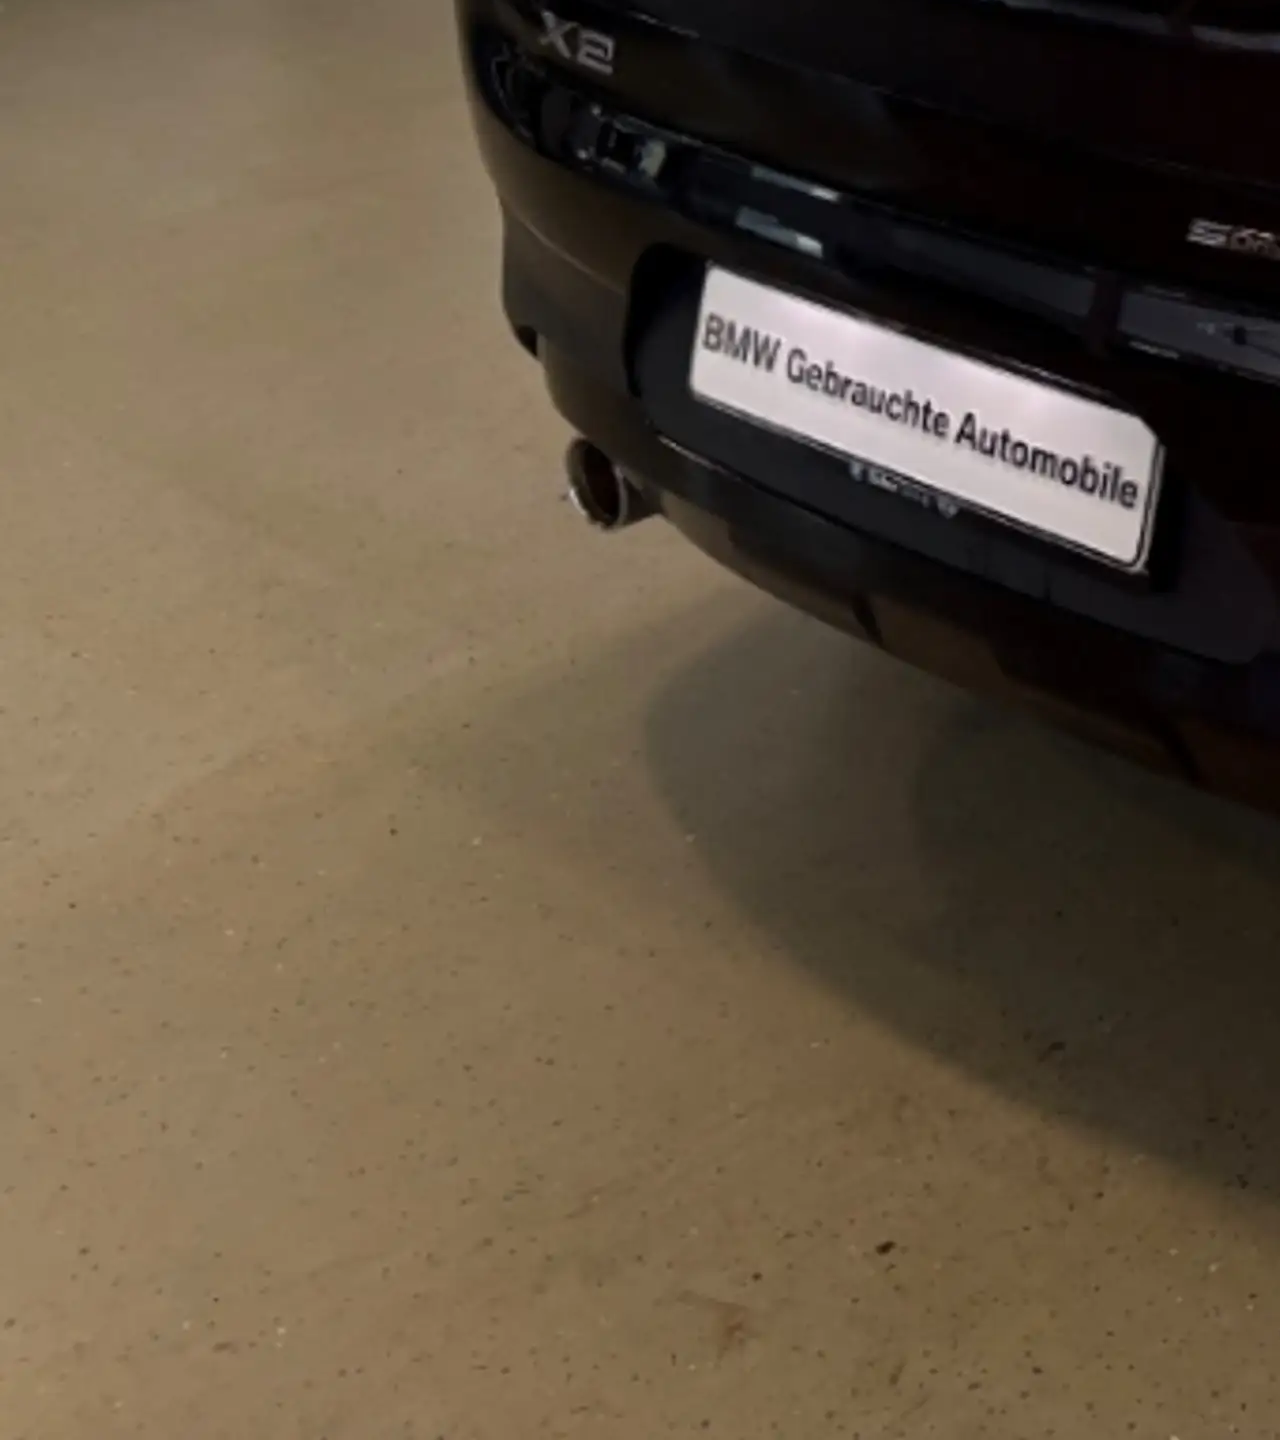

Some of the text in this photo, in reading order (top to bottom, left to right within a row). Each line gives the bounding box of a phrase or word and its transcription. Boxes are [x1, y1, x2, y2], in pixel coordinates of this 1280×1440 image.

[539, 10, 614, 74] X2
[702, 313, 782, 372] BMW
[787, 348, 949, 437] Gebrauchte
[956, 413, 1138, 509] Automobile
